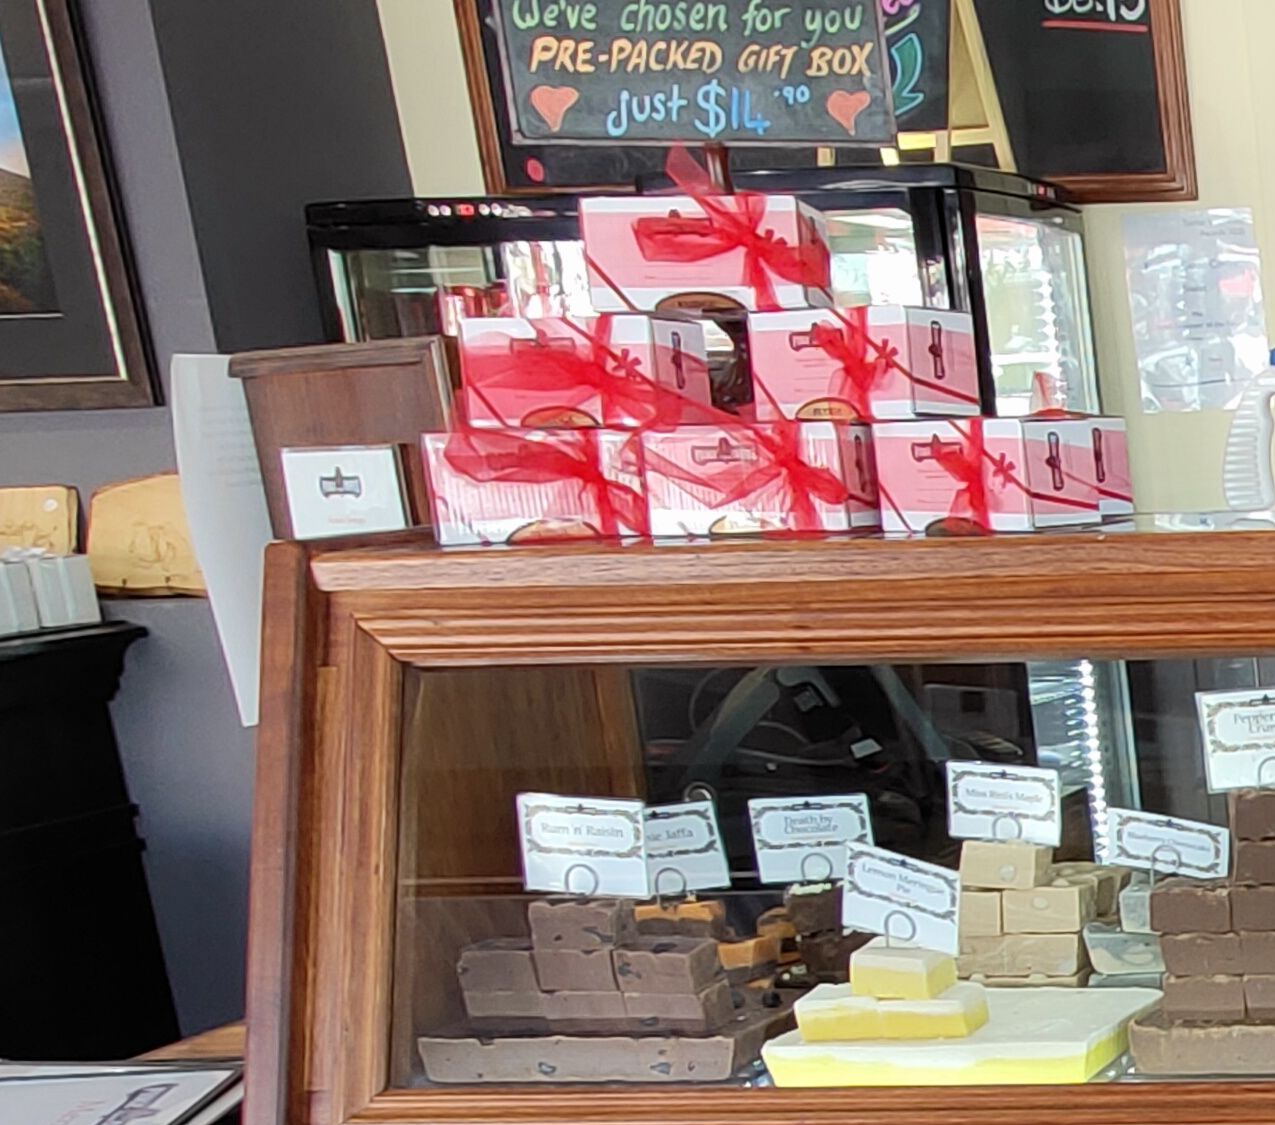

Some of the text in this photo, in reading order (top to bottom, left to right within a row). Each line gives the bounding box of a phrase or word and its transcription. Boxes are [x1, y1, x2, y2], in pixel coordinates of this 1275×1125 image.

[512, 0, 862, 48] We've chosen for you
[530, 35, 874, 79] PRE-PACKED GIFT BOX
[606, 83, 688, 137] just
[540, 823, 569, 835] Rum
[587, 825, 624, 838] Raisin
[665, 828, 694, 840] Jaffa
[862, 863, 897, 881] Lemon
